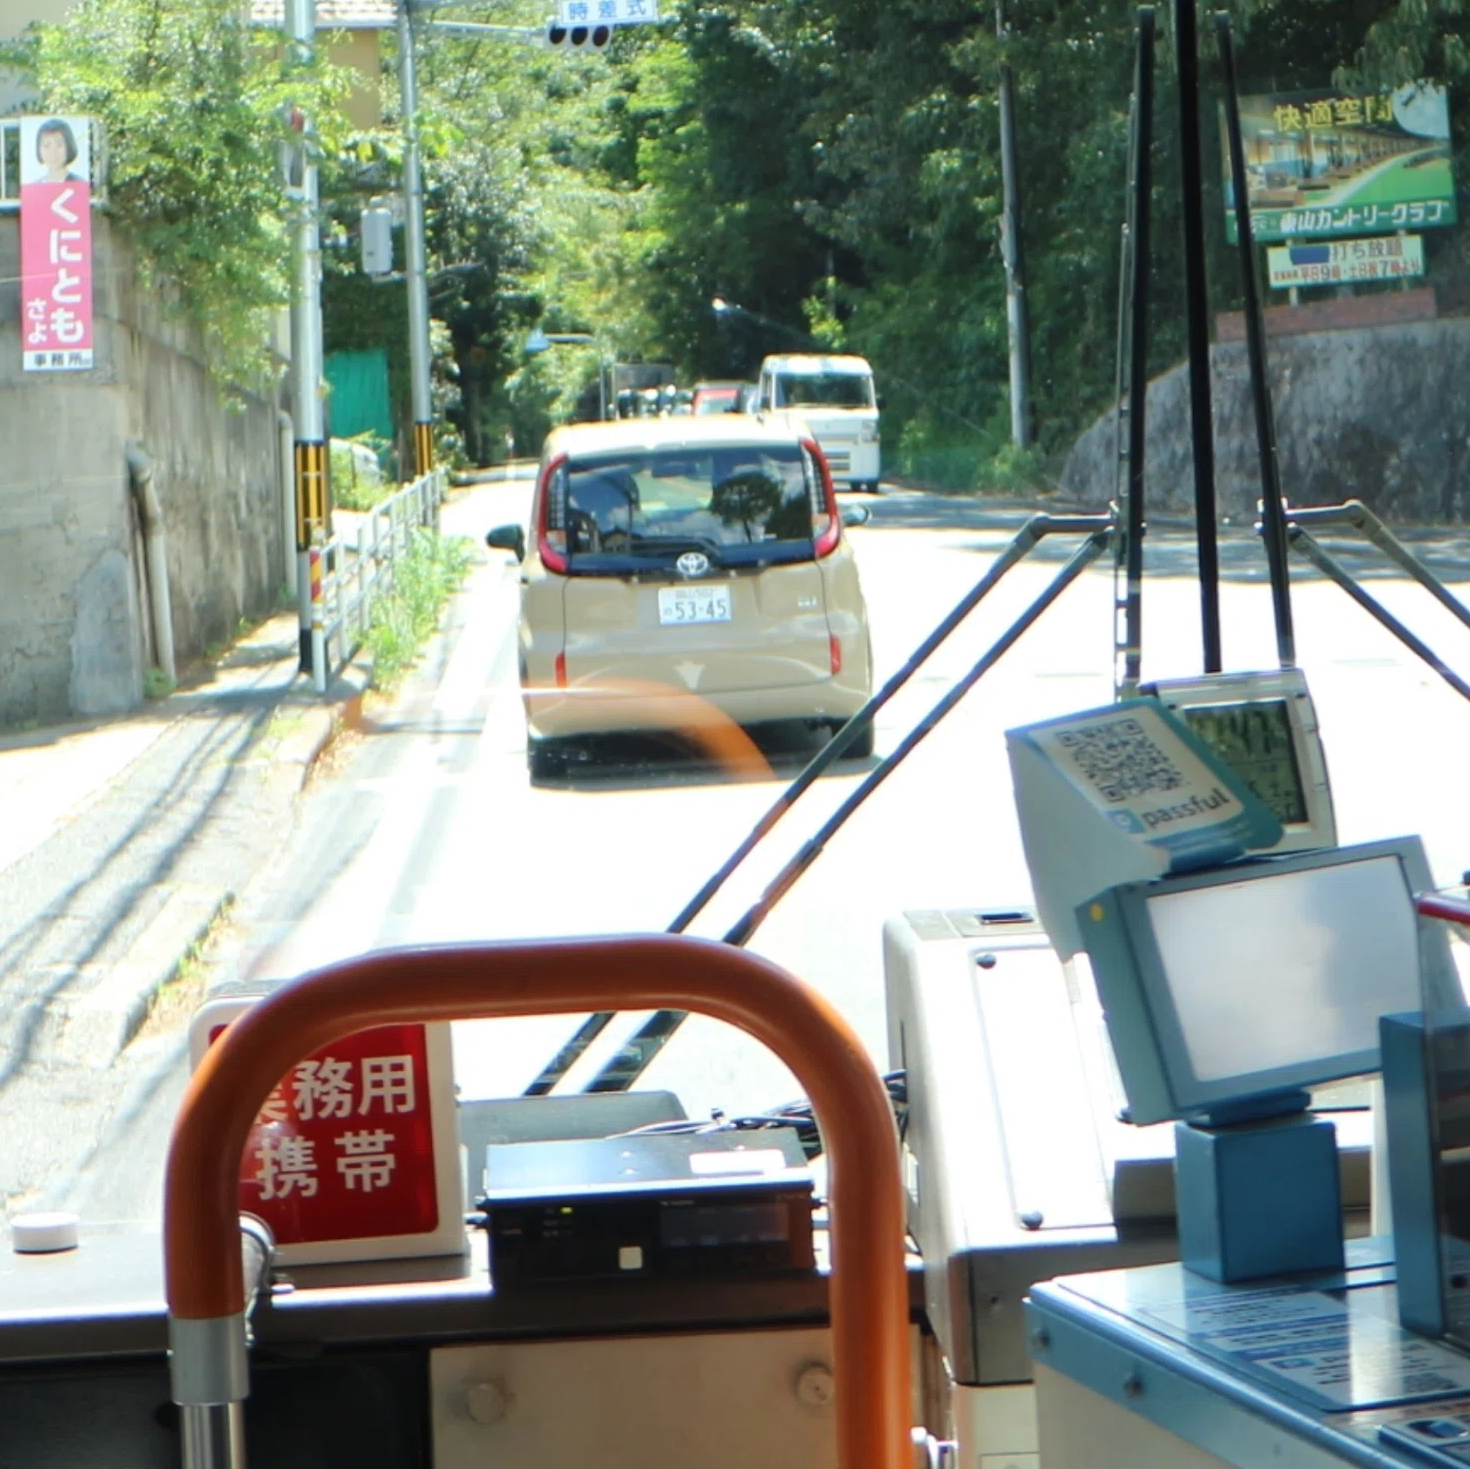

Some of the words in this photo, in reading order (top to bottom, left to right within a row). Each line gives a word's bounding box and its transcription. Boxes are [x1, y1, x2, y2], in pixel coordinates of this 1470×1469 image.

[1273, 95, 1393, 132] 快適空間
[1280, 198, 1450, 234] 東山カントリークラブ
[49, 187, 85, 344] くにとも
[26, 296, 47, 345] さよ
[34, 352, 79, 368] 事務所
[674, 598, 728, 622] 53-45
[1142, 787, 1229, 828] passful
[255, 1129, 396, 1201] 携帯
